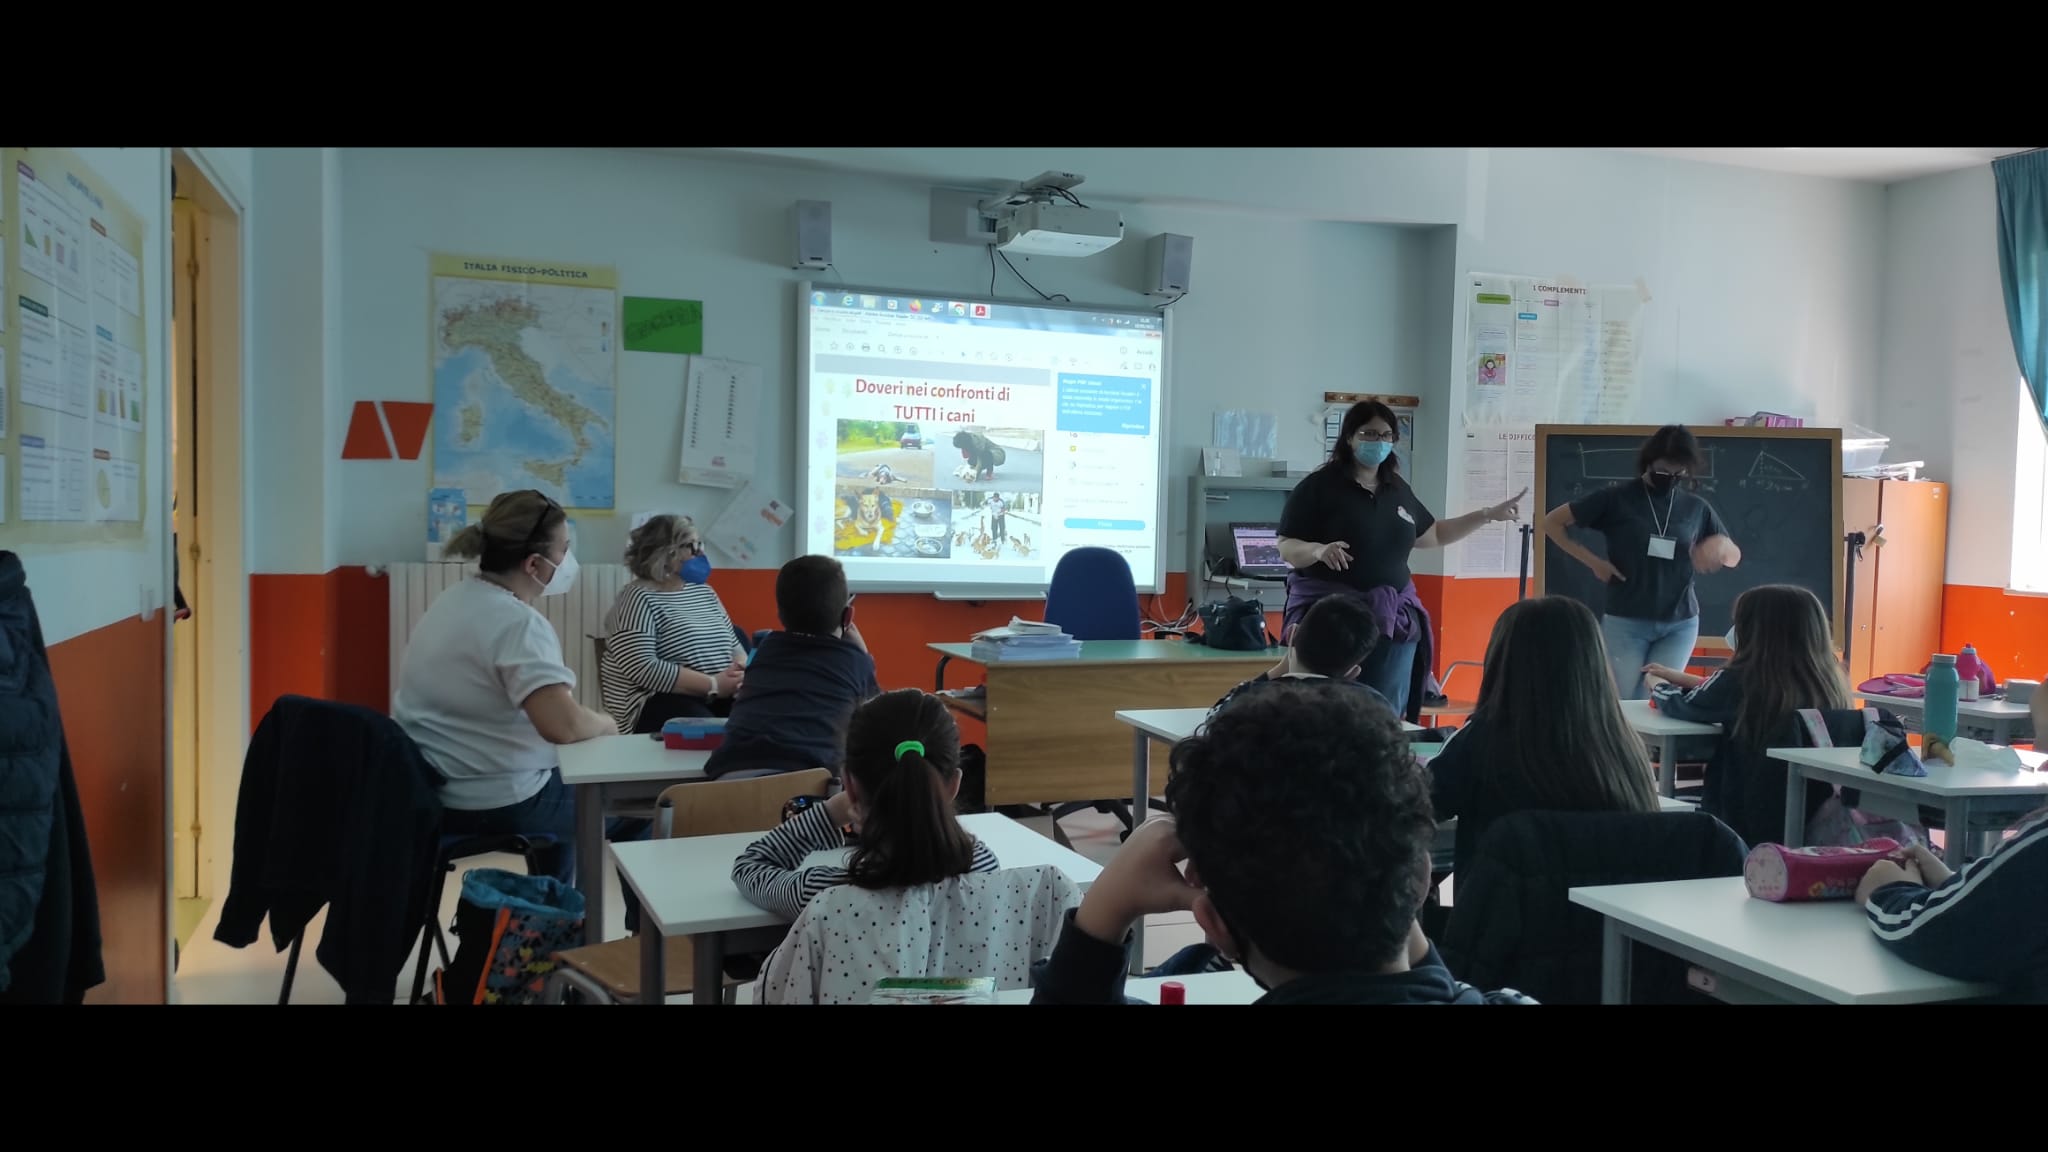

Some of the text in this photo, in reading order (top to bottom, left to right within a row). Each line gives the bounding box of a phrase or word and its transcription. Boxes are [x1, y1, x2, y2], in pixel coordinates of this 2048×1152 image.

[464, 262, 588, 278] ITALIA FISICO-POLITICA
[1538, 285, 1586, 295] COMPLEMENTI
[856, 378, 1010, 401] Doveri nei confronti di
[893, 405, 975, 423] TUTTI i cani
